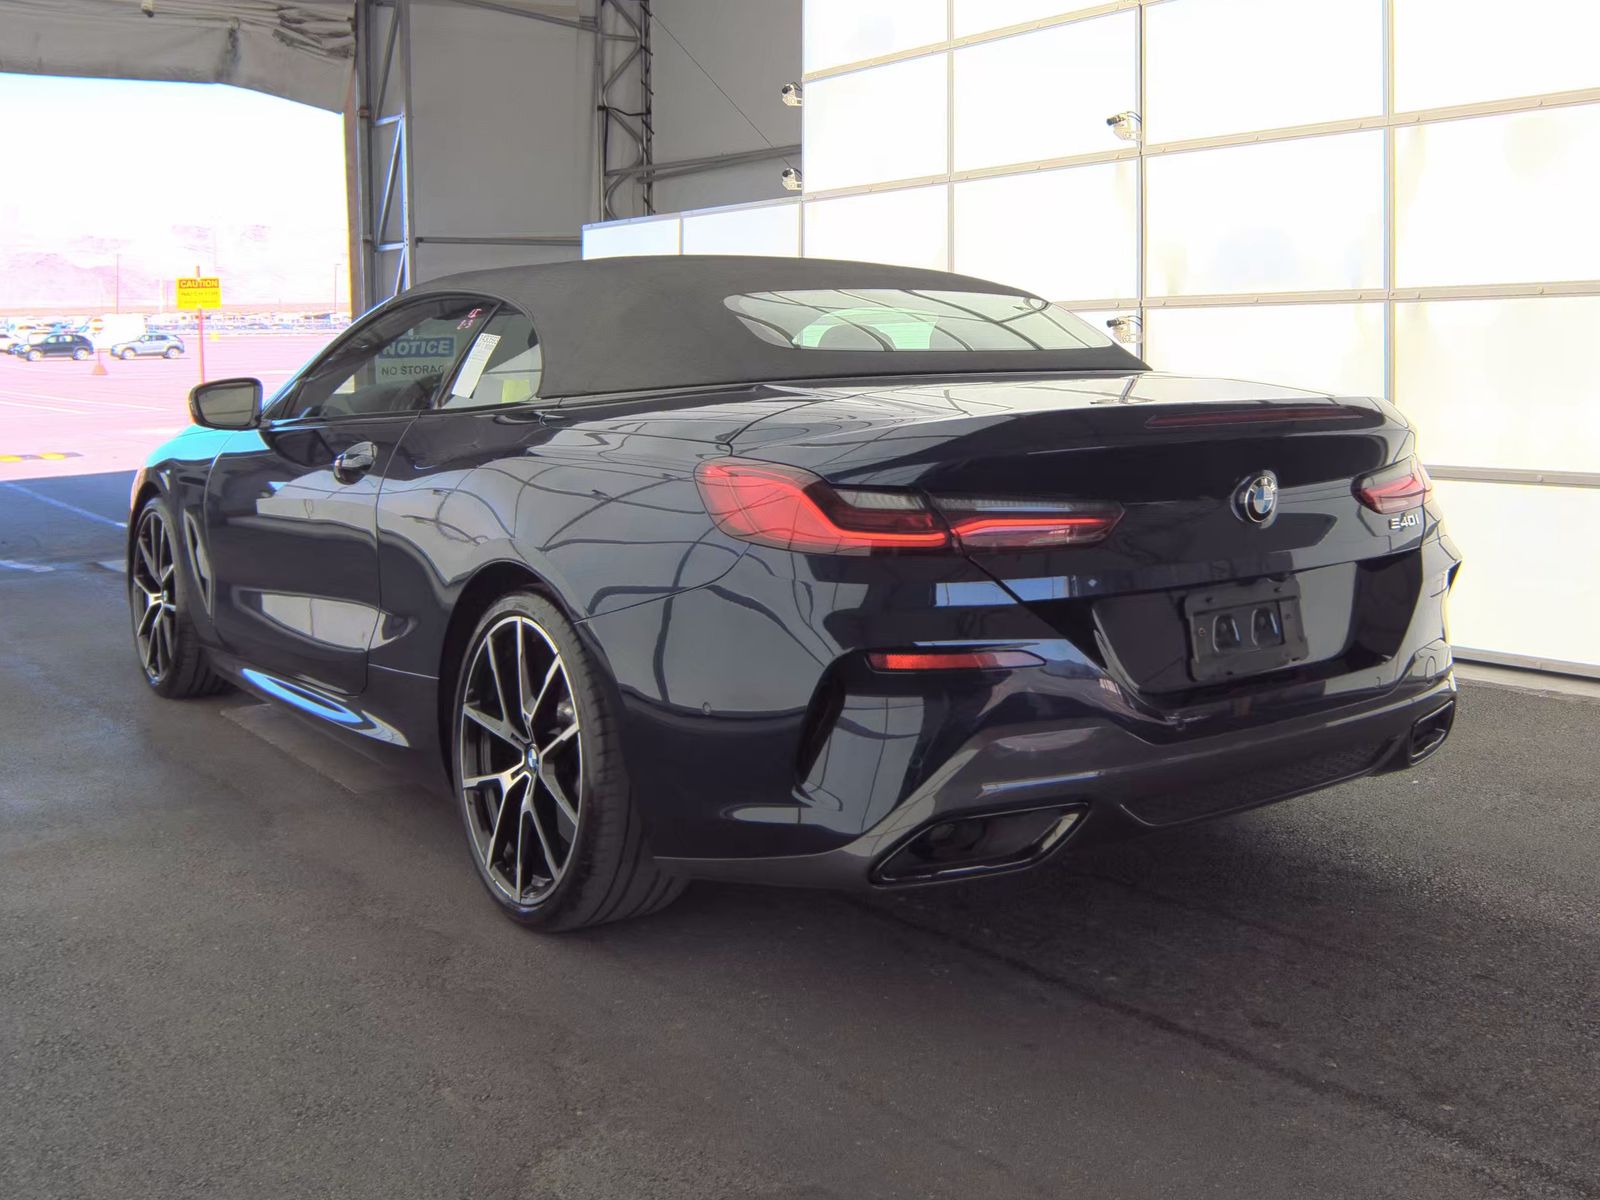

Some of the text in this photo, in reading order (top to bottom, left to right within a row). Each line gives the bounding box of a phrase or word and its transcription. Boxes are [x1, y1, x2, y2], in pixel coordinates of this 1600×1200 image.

[180, 280, 217, 288] CAUTION
[383, 340, 450, 355] NOTICE
[381, 366, 398, 376] NO
